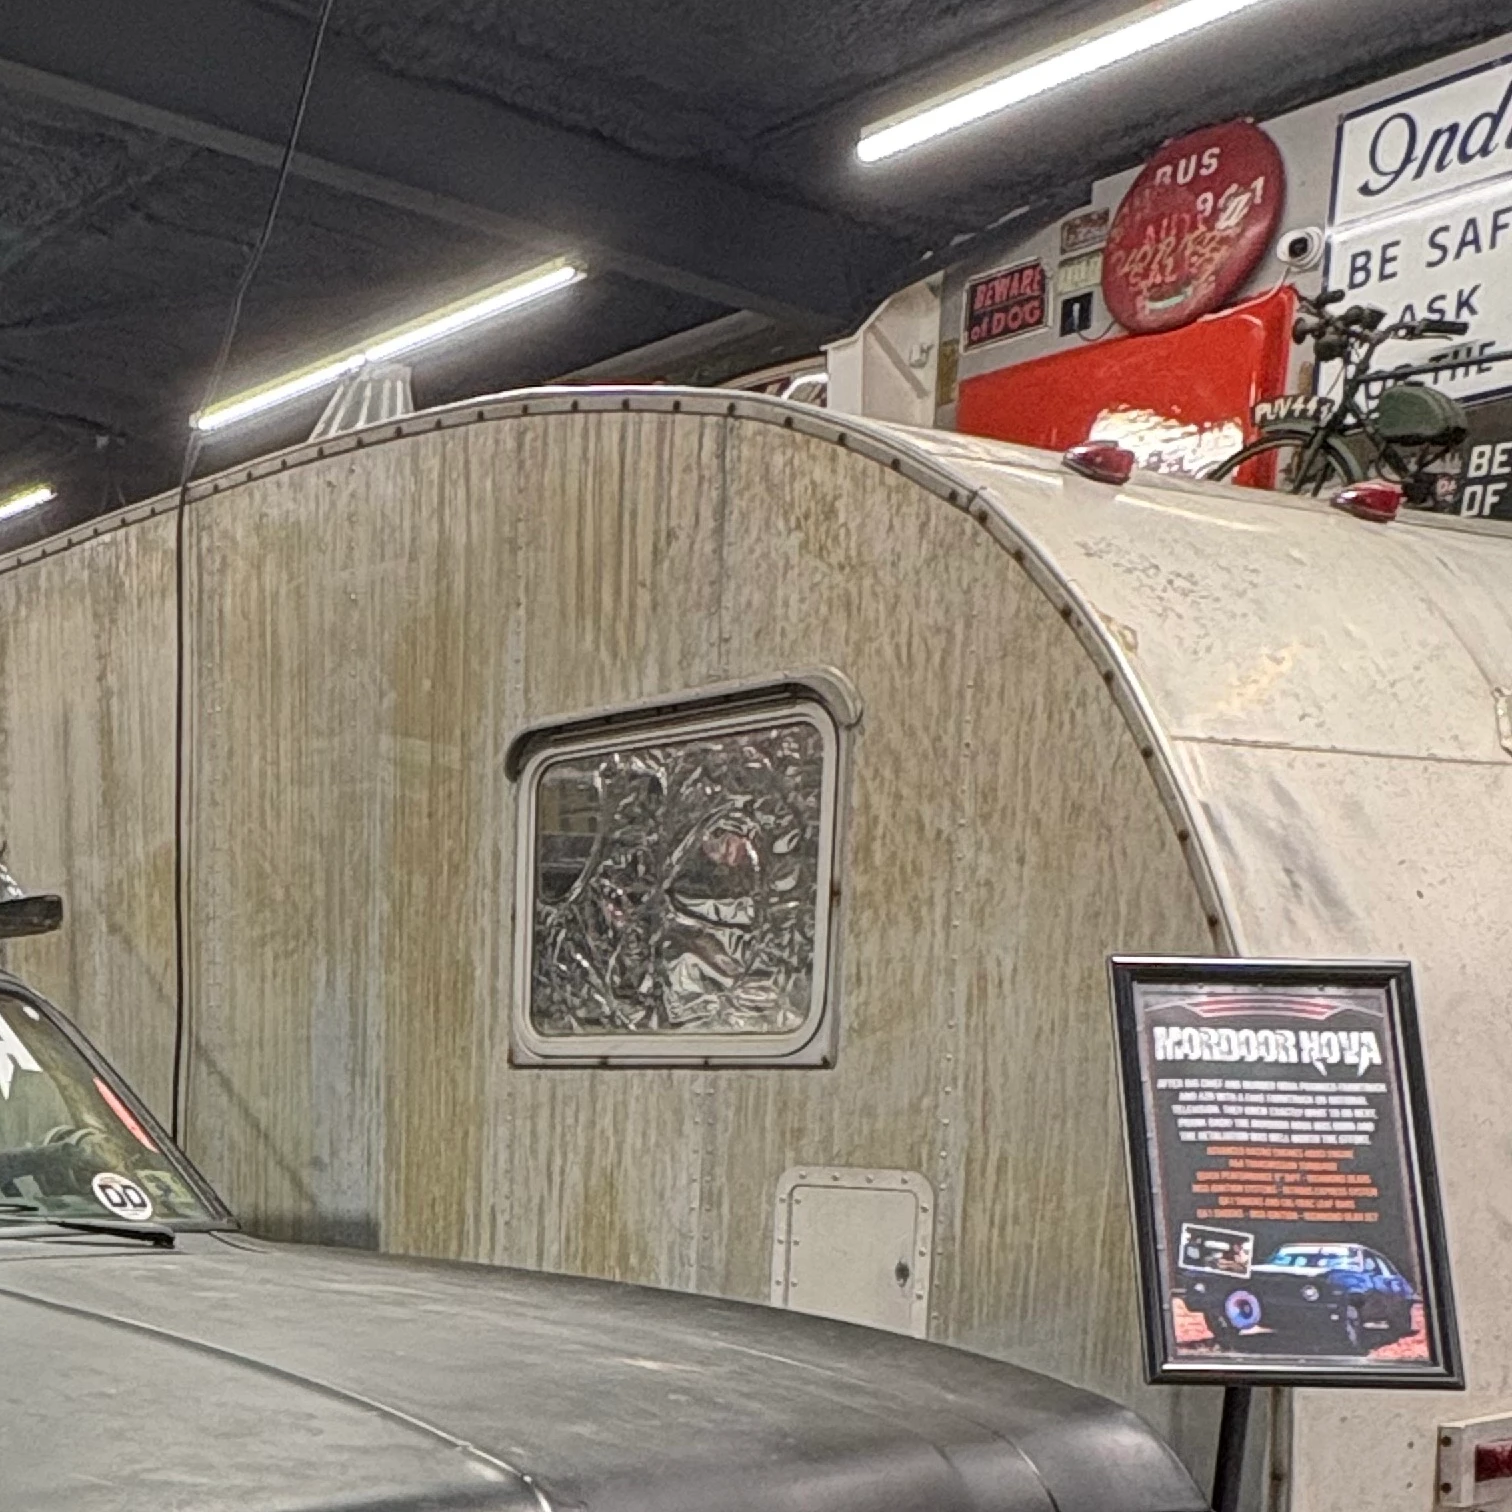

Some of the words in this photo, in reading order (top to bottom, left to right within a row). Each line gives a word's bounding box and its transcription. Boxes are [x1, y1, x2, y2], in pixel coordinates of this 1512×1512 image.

[1357, 78, 1512, 197] Ind
[1348, 240, 1401, 291] BE
[991, 300, 1042, 335] DOG
[1398, 284, 1481, 330] ASK
[1461, 482, 1508, 517] OF
[1153, 1026, 1298, 1064] MORDOOR
[1299, 1030, 1382, 1077] NOVA
